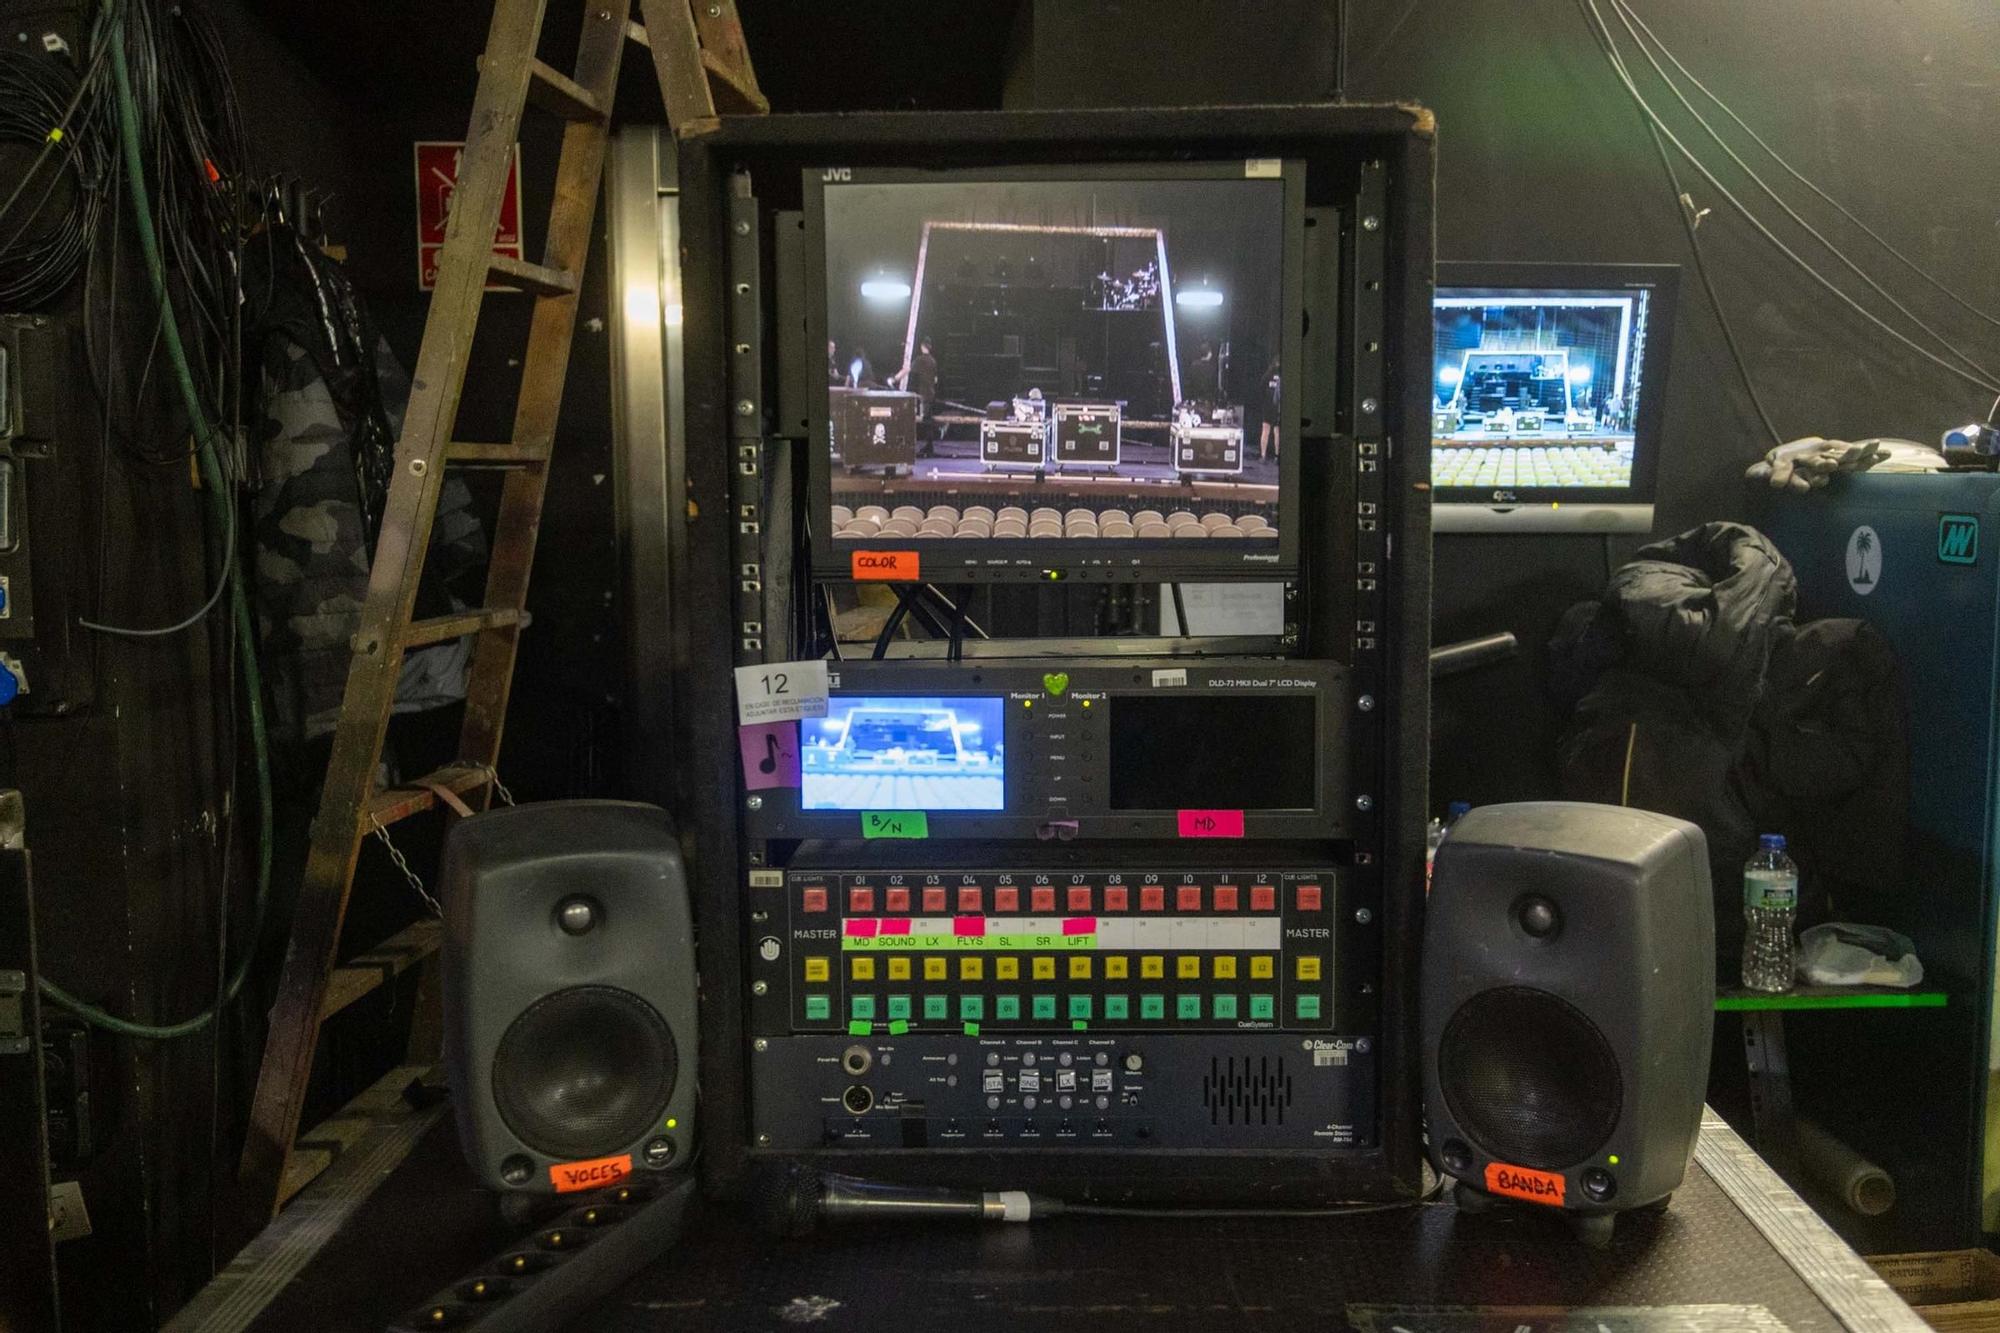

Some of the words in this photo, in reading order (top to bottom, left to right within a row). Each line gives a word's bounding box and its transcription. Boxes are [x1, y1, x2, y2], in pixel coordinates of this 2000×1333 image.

[822, 167, 852, 181] JVC
[858, 556, 897, 570] COLOR
[761, 673, 789, 695] 12
[1208, 679, 1235, 687] DLD-72
[1252, 679, 1268, 687] Dual
[1277, 679, 1293, 687] LCD
[1294, 679, 1317, 688] Display
[1010, 692, 1039, 700] Monitor
[1071, 692, 1099, 700] Monitor
[871, 814, 902, 833] B/N
[1194, 817, 1216, 831] MD
[855, 875, 866, 885] 01
[890, 875, 903, 885] 02
[926, 875, 940, 885] 03
[962, 875, 976, 885] 04
[999, 875, 1012, 885] 05
[1035, 875, 1049, 885] 06
[1072, 875, 1085, 885] 07
[1108, 875, 1121, 885] 08
[1145, 874, 1159, 884] 09
[1183, 874, 1194, 884] 10
[1221, 874, 1229, 884] 11
[1257, 874, 1268, 884] 12
[794, 929, 837, 939] MASTER
[1286, 928, 1330, 938] MASTER
[853, 937, 870, 946] MD
[878, 937, 916, 946] SOUND
[926, 937, 939, 946] LX
[957, 936, 984, 946] FLYS
[999, 937, 1012, 946] SL
[1036, 937, 1051, 946] SR
[1067, 937, 1089, 946] LIFT
[1238, 1020, 1274, 1029] CueSystem
[1313, 1039, 1354, 1050] Clear-Com
[1021, 1079, 1038, 1087] SND
[564, 1162, 622, 1185] VOCES
[1498, 1170, 1559, 1197] BANDA
